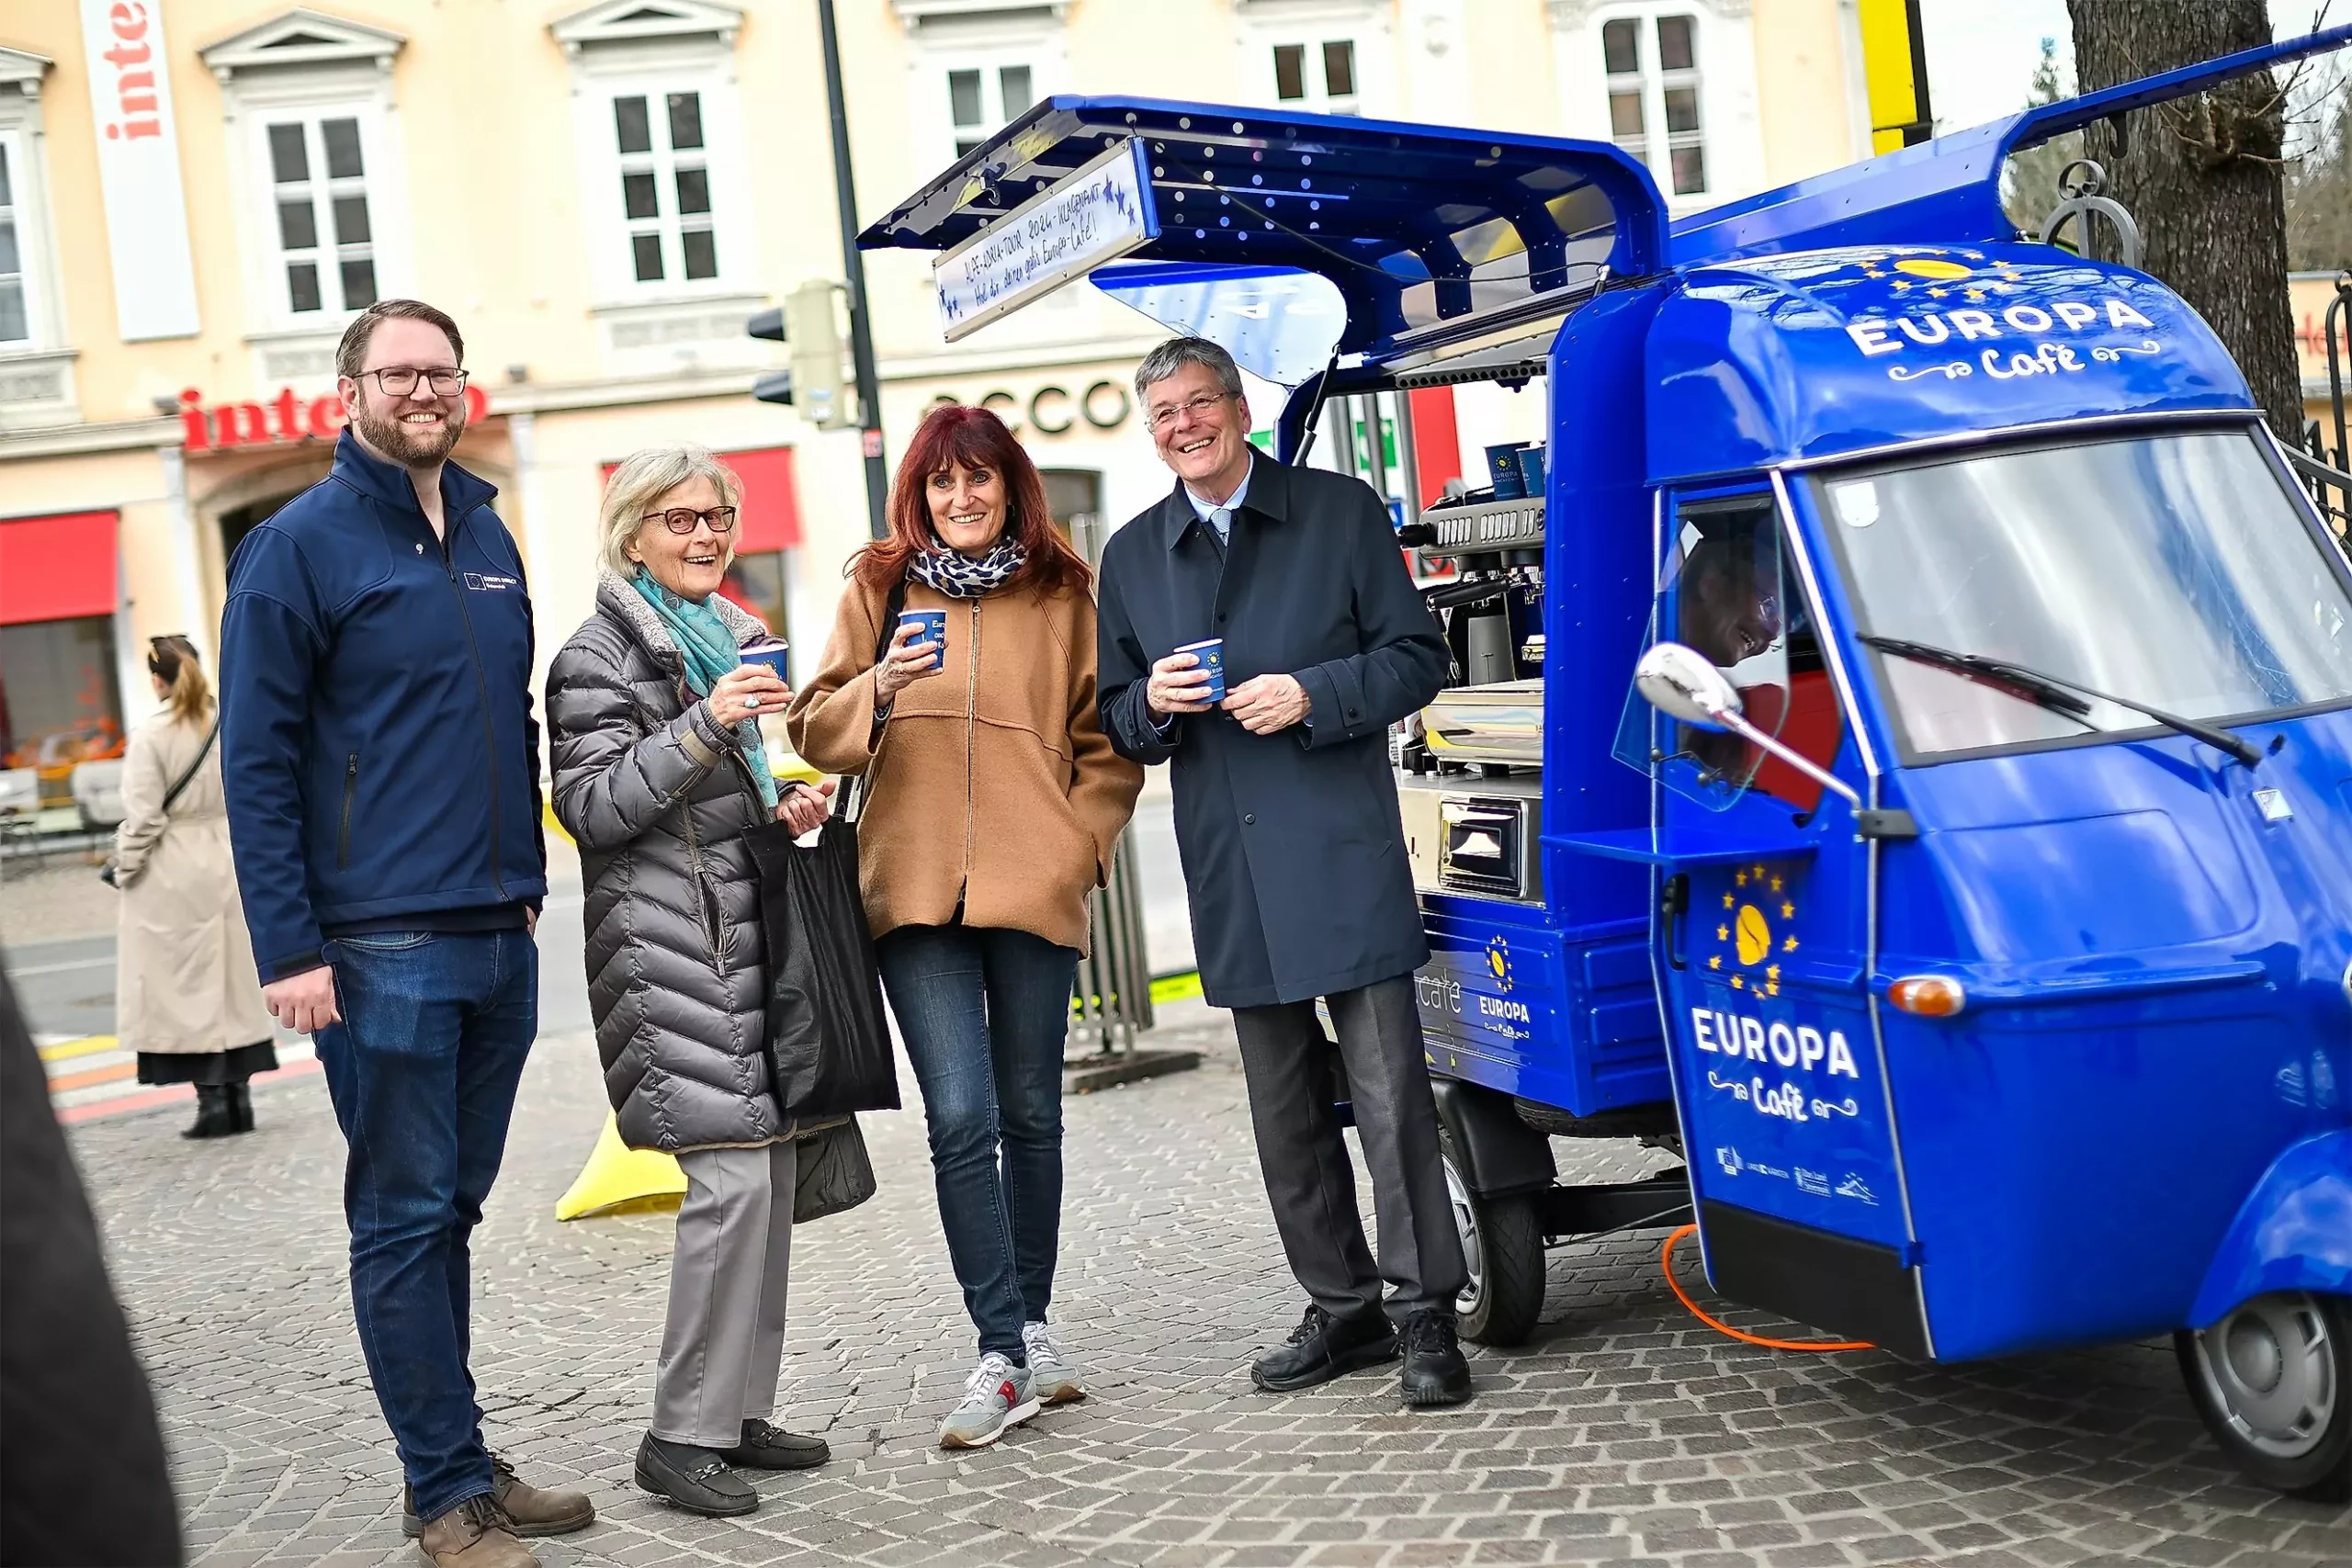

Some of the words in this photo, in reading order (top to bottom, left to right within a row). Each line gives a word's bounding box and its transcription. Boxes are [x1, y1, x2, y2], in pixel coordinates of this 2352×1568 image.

[1845, 299, 2154, 356] EUROPA
[1981, 343, 2086, 380] Café
[1479, 995, 1531, 1024] EUROPA
[1691, 1007, 1860, 1079] EUROPA
[1752, 1077, 1809, 1122] Café
